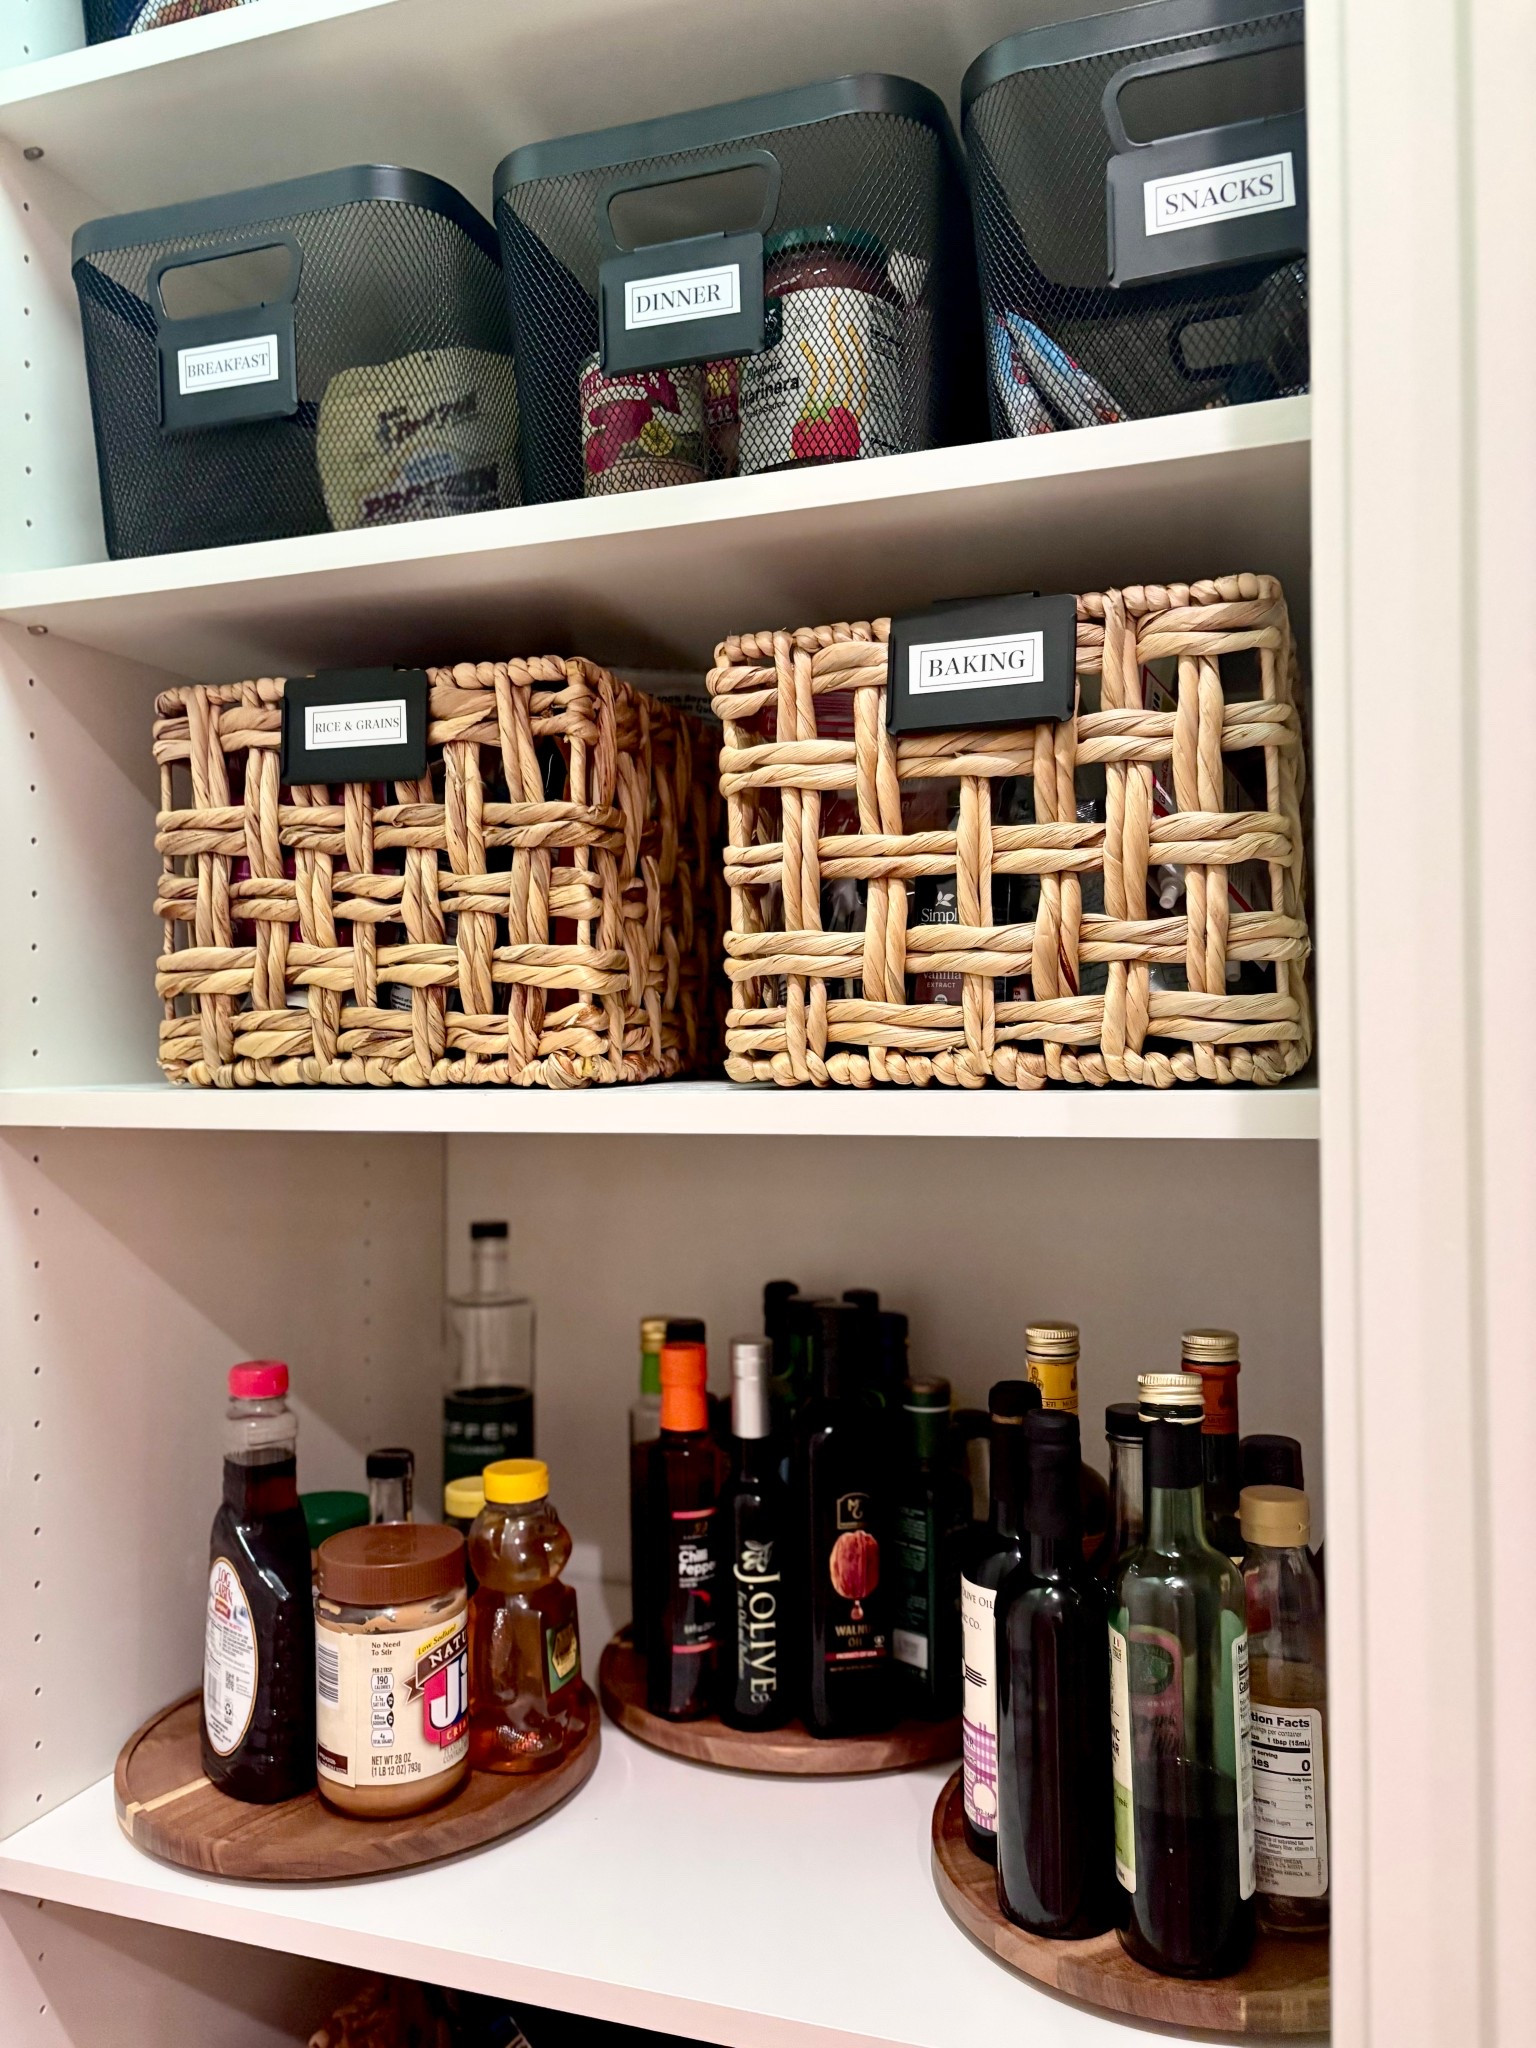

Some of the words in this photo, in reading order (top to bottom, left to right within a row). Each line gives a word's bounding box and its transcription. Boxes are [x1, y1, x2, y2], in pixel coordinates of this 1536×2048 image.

[1165, 173, 1275, 216] SNACKS
[636, 283, 722, 314] DINNER
[188, 352, 269, 378] BREAKFAST
[928, 649, 1026, 678] BAKING
[315, 721, 341, 733] RICE
[344, 721, 353, 731] &
[356, 717, 400, 730] GRAINS
[926, 981, 956, 989] EXTRACT
[978, 1596, 994, 1610] OIL
[418, 1642, 431, 1655] Low
[376, 1675, 389, 1685] 190
[1251, 1711, 1273, 1726] tion
[1276, 1716, 1310, 1728] Facts
[1273, 1737, 1288, 1746] tbsp
[371, 1756, 383, 1766] NET
[384, 1755, 393, 1765] WT
[403, 1752, 412, 1763] OZ
[1257, 1750, 1278, 1760] serving
[371, 1767, 378, 1778] (1
[379, 1766, 386, 1777] LB
[388, 1766, 395, 1776] 12
[395, 1763, 407, 1776] OZ)
[408, 1762, 422, 1773] 793g
[1301, 1759, 1311, 1772] 0
